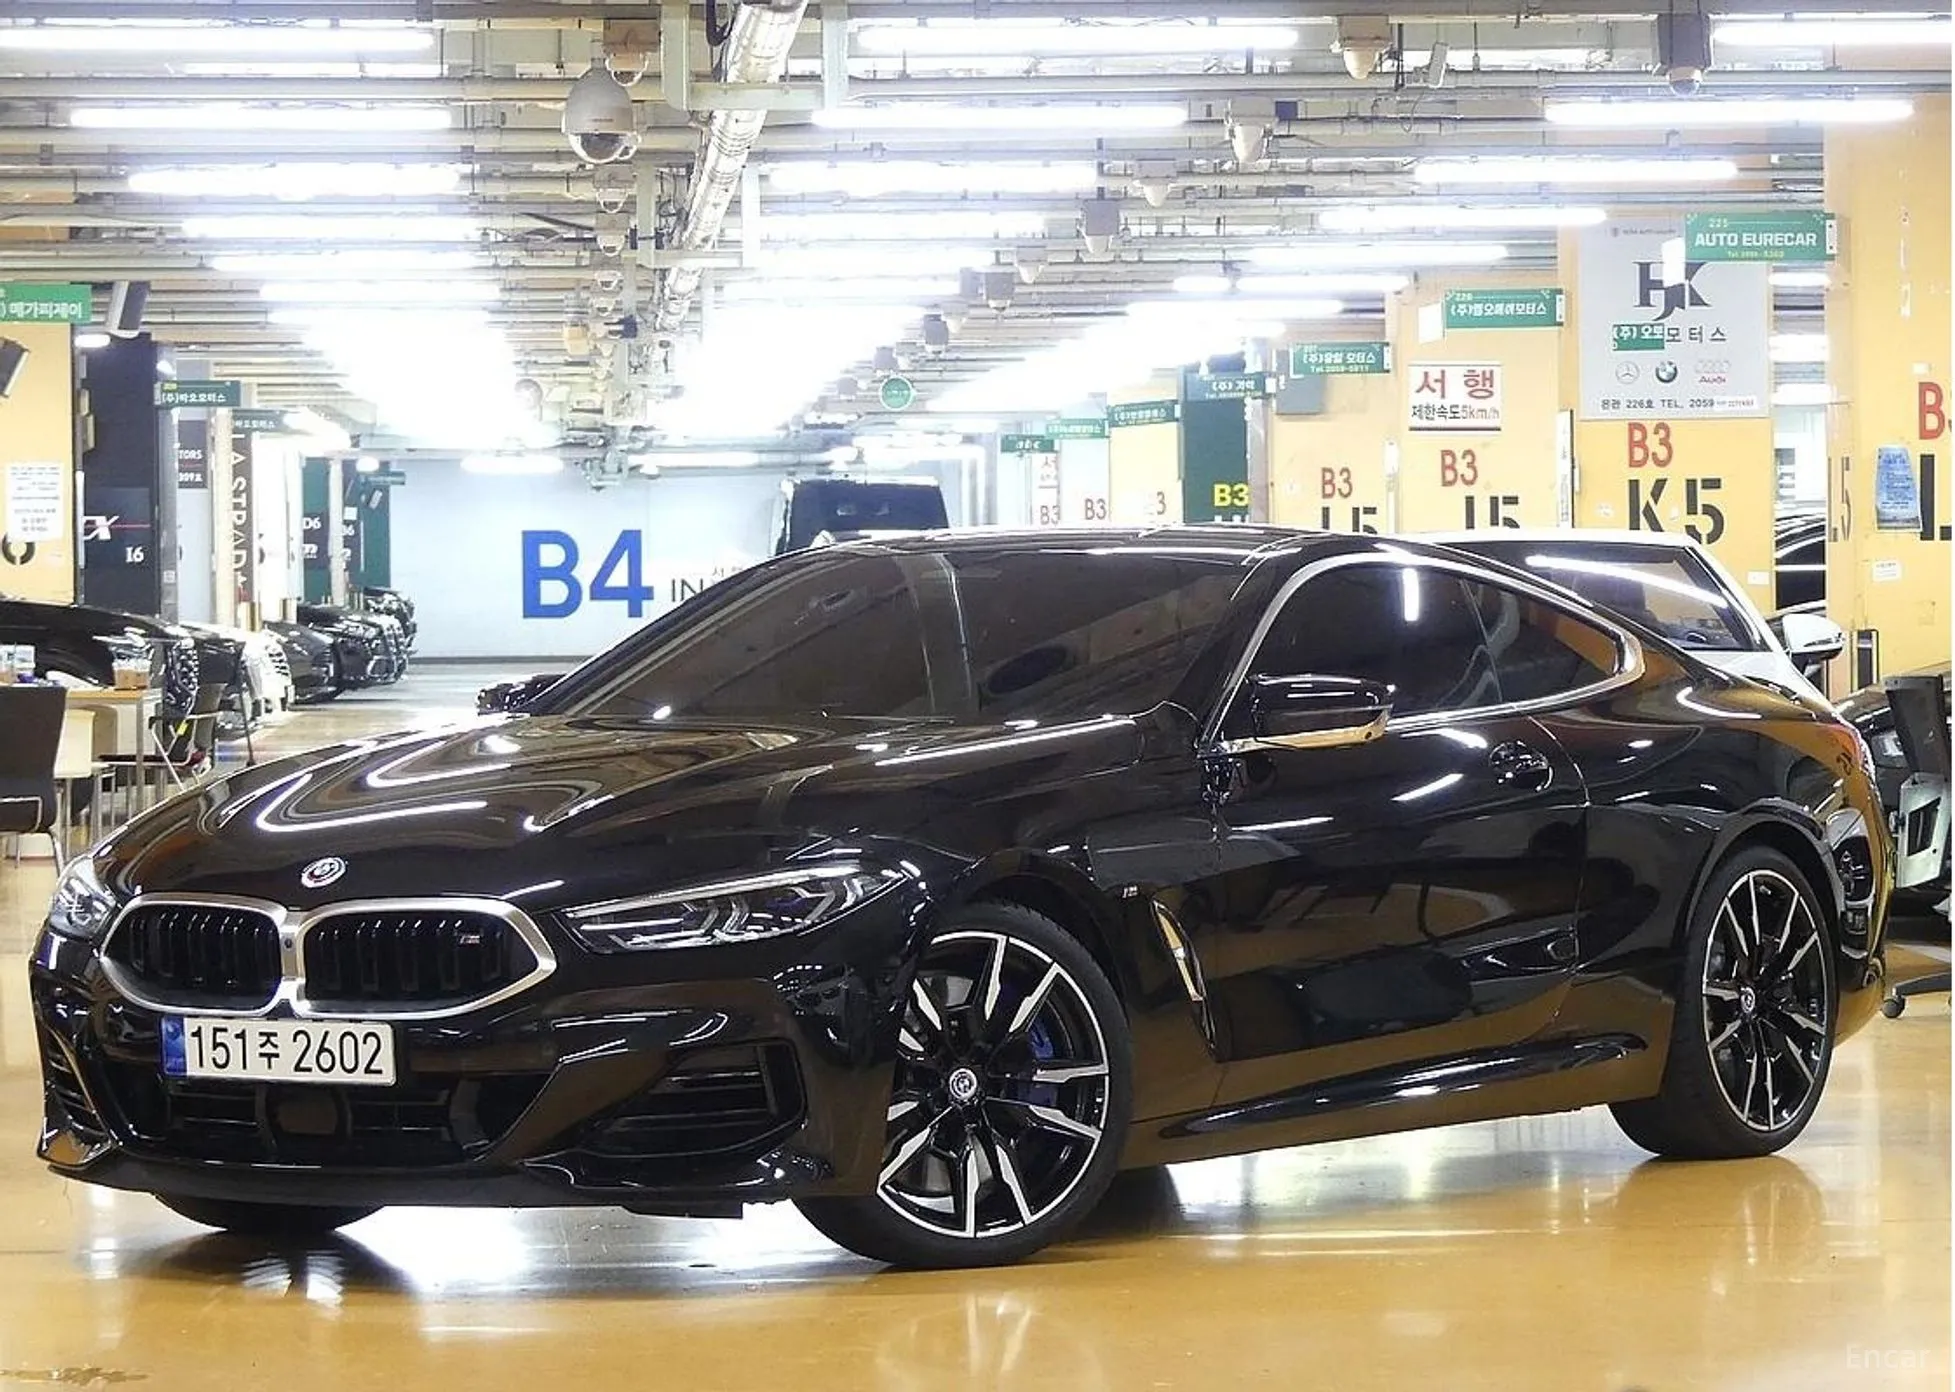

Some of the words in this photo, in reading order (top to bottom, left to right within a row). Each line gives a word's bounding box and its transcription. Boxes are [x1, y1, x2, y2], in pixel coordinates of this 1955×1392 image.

[1695, 232, 1738, 247] AUTO
[1742, 232, 1817, 247] EURECAR
[9, 301, 82, 319] 메가피제이
[1918, 381, 1952, 440] B
[1628, 422, 1673, 468] B3
[1321, 467, 1353, 500] B3
[1440, 449, 1478, 487] B3
[1083, 498, 1107, 521] B3
[1213, 483, 1249, 507] B3
[521, 530, 654, 619] B4
[190, 1024, 281, 1071] 151주
[292, 1029, 384, 1075] 2602
